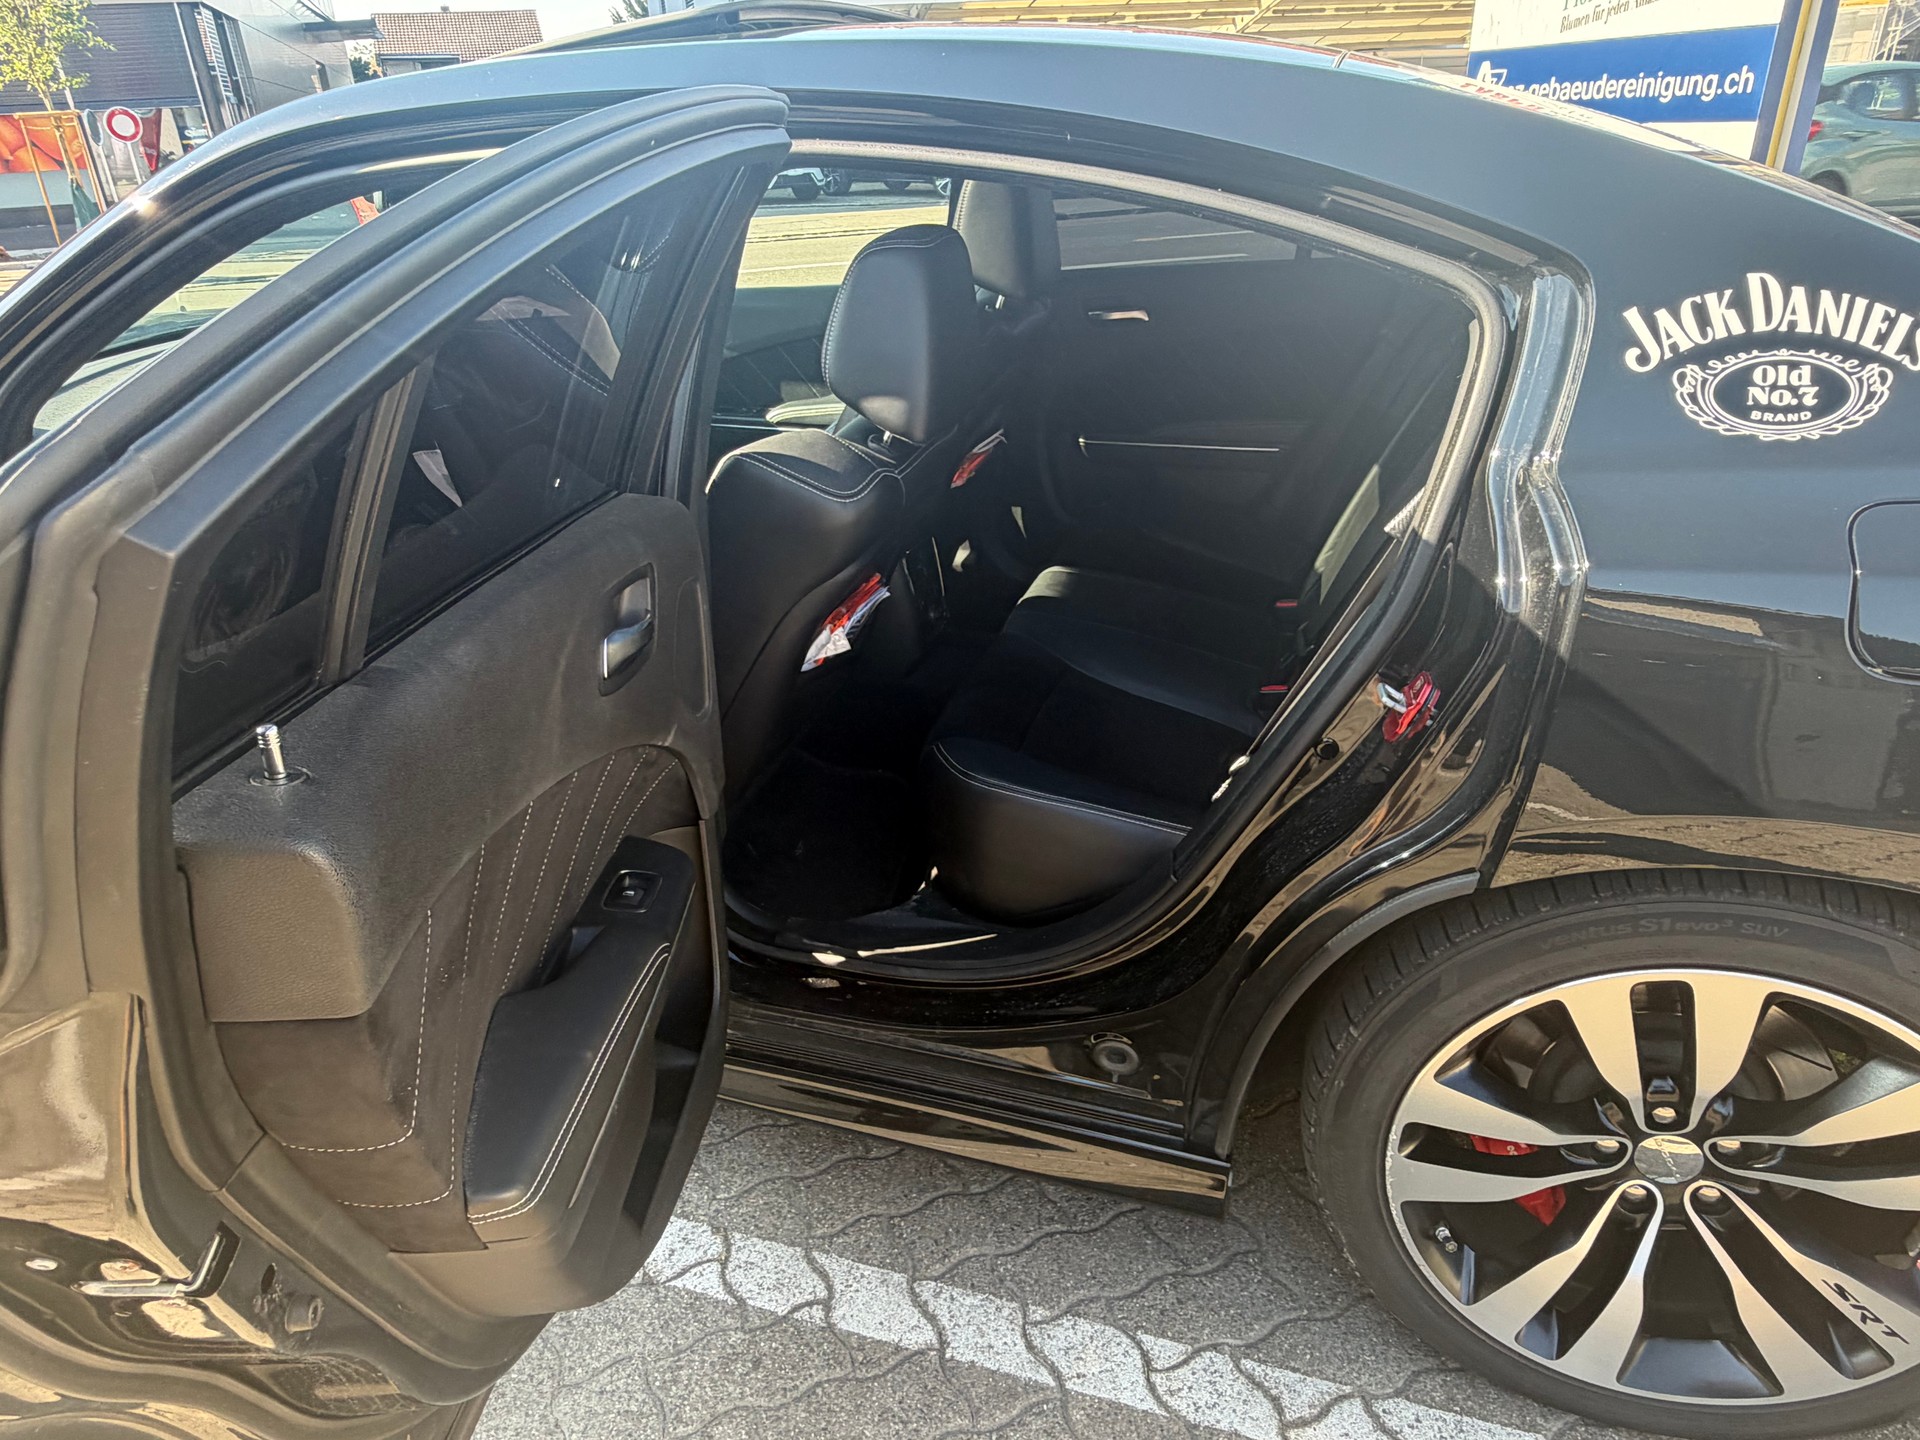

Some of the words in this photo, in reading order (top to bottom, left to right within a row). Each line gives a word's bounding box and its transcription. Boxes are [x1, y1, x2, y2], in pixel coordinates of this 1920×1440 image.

[1559, 13, 1591, 34] Blumen
[1622, 288, 1746, 373] JACK
[1752, 364, 1812, 387] Old
[1750, 410, 1812, 422] BRAND
[1741, 922, 1790, 938] SUV
[1820, 1278, 1910, 1345] SRT
